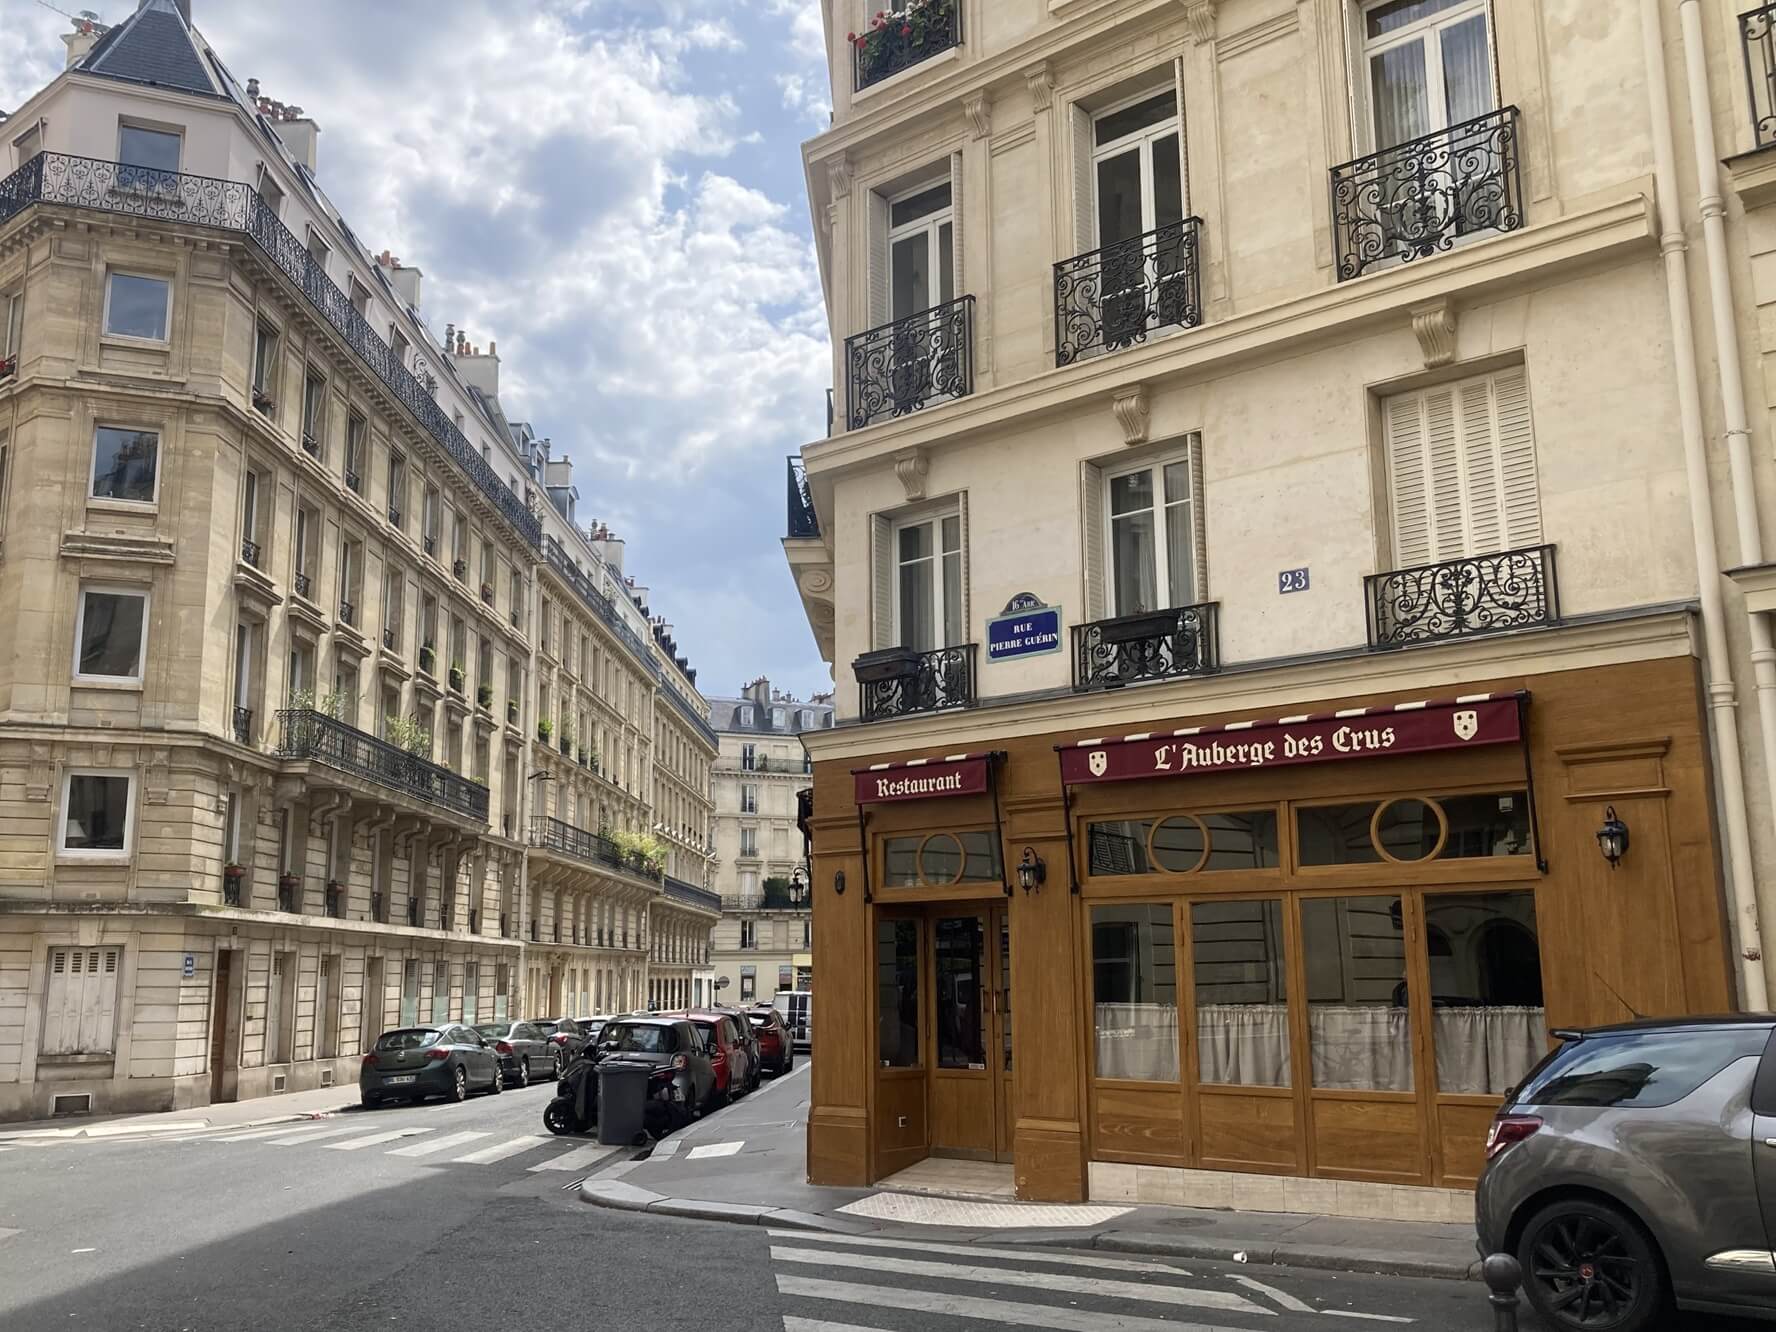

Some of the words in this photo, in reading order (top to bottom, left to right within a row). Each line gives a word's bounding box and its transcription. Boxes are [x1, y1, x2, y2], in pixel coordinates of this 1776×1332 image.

[1281, 570, 1306, 592] 23
[1013, 622, 1033, 634] RUE
[990, 638, 1023, 652] PIERRE
[1025, 632, 1058, 646] GUÉRIN
[1153, 741, 1276, 772] L'Auberge
[1283, 733, 1323, 759] des
[1331, 725, 1396, 753] Crus
[875, 771, 962, 798] Restaurant
